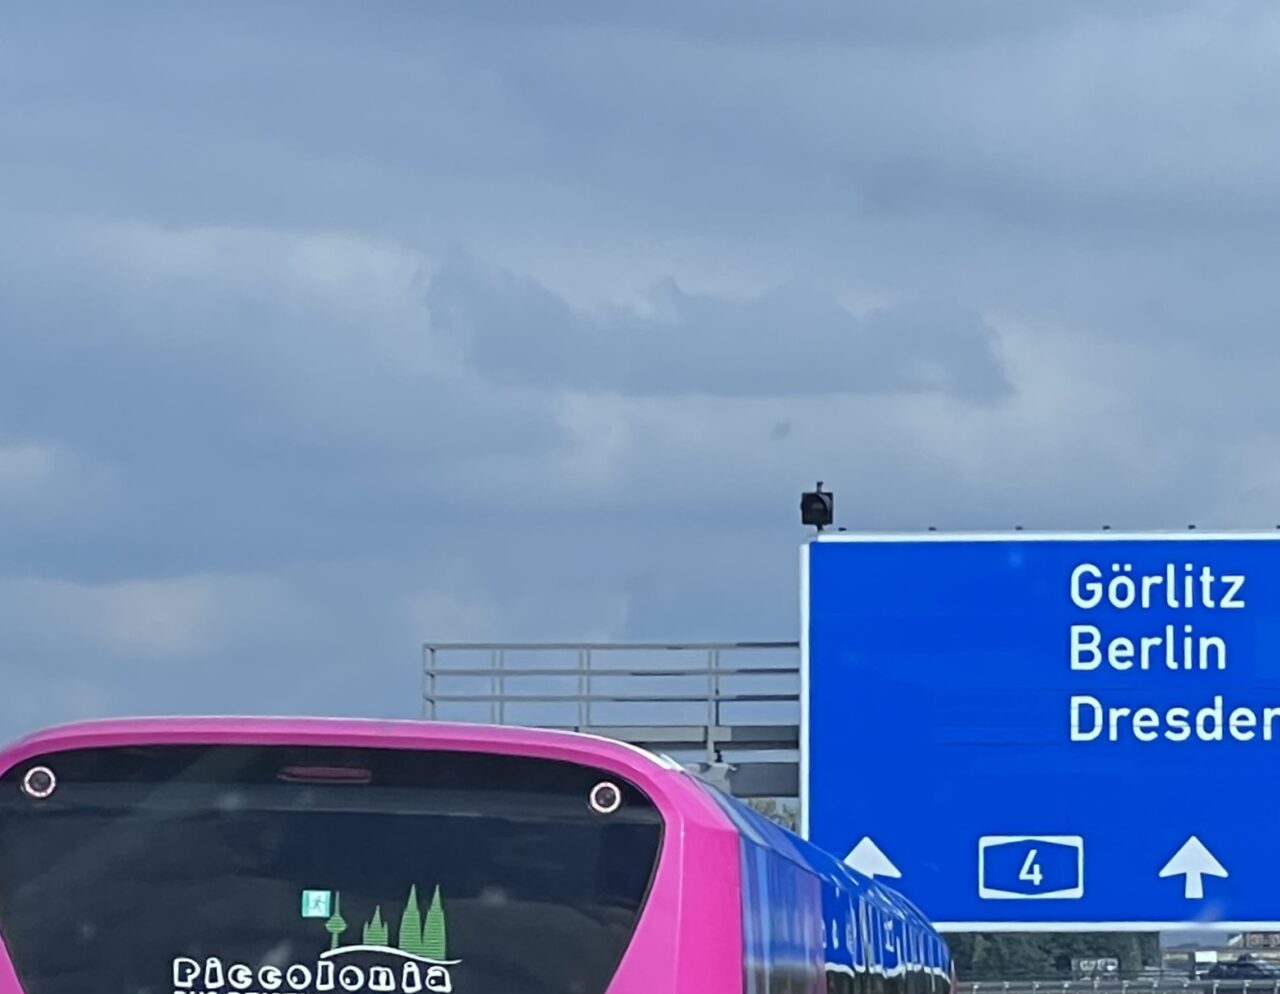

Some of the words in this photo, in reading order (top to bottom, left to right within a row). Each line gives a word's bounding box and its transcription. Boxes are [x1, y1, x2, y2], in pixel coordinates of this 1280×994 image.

[1070, 563, 1246, 609] Görlitz
[1070, 624, 1226, 671] Berlin
[1018, 848, 1043, 886] 4
